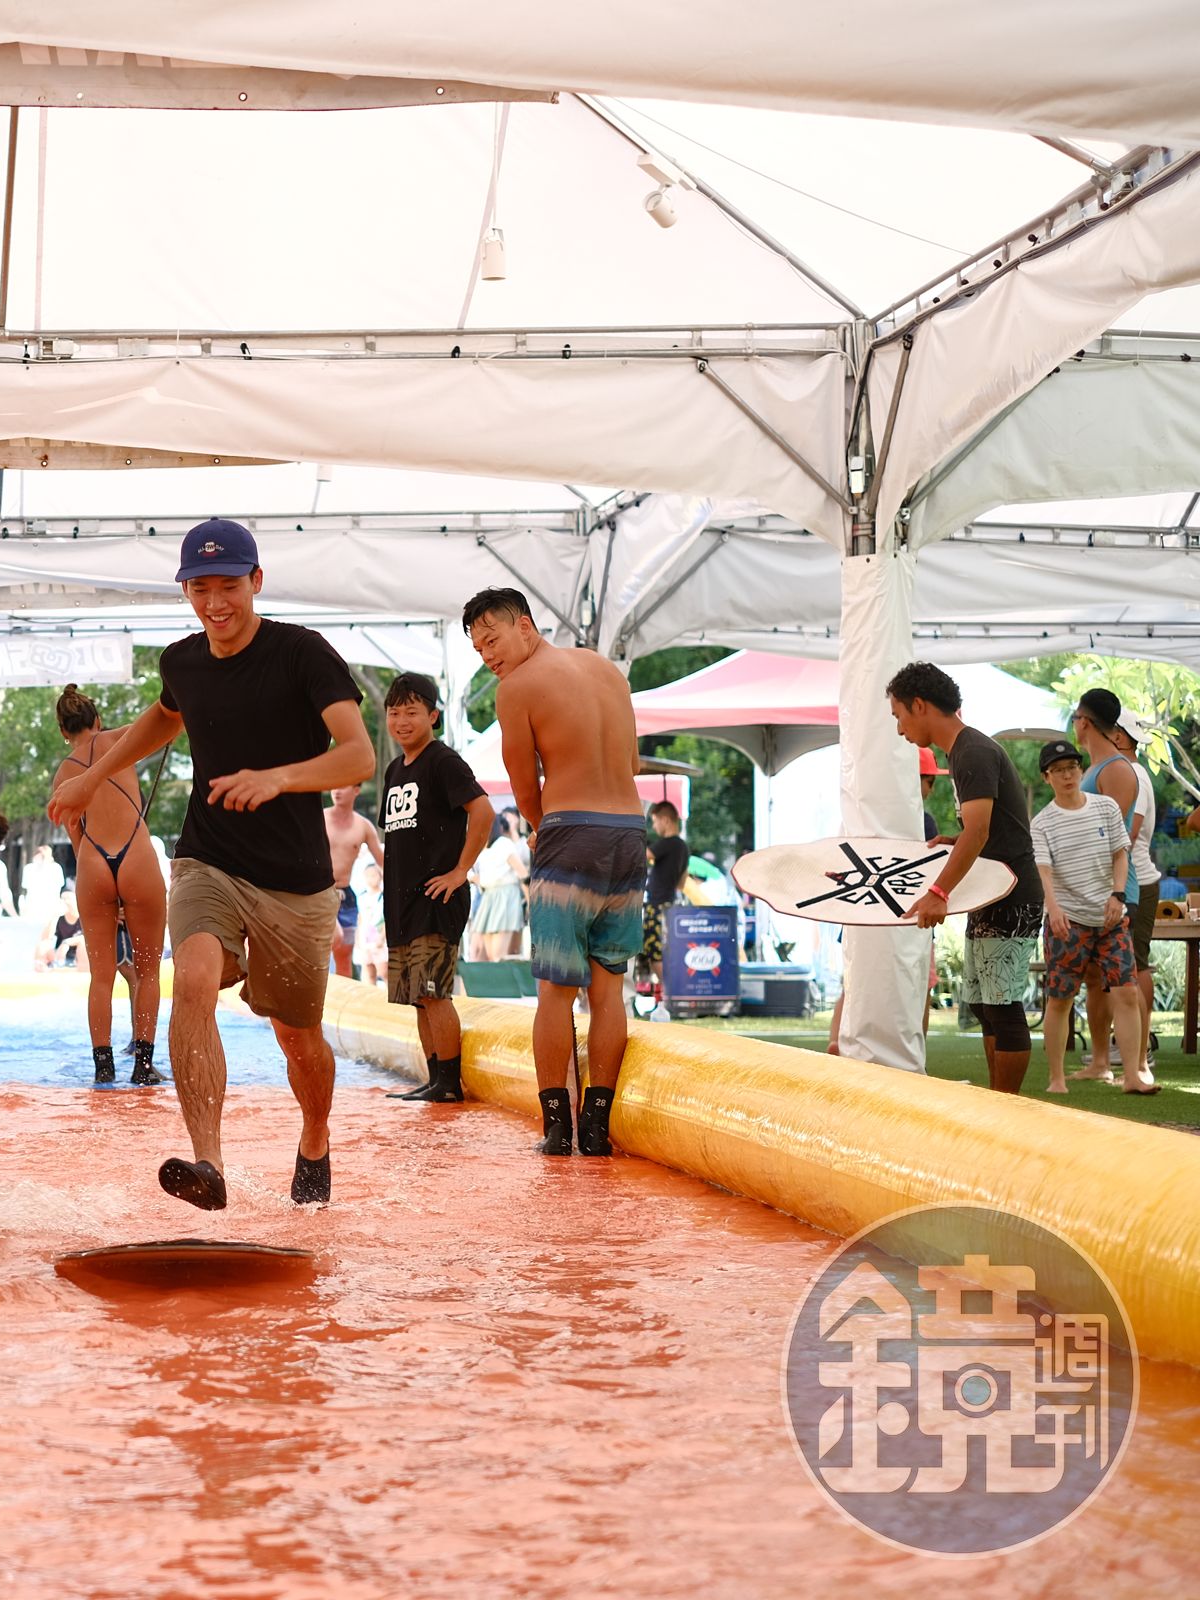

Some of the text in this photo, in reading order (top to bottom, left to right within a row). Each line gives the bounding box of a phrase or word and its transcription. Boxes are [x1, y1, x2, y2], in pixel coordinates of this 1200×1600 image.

[887, 870, 927, 897] PRO
[548, 1099, 559, 1107] 28
[595, 1098, 606, 1107] 28
